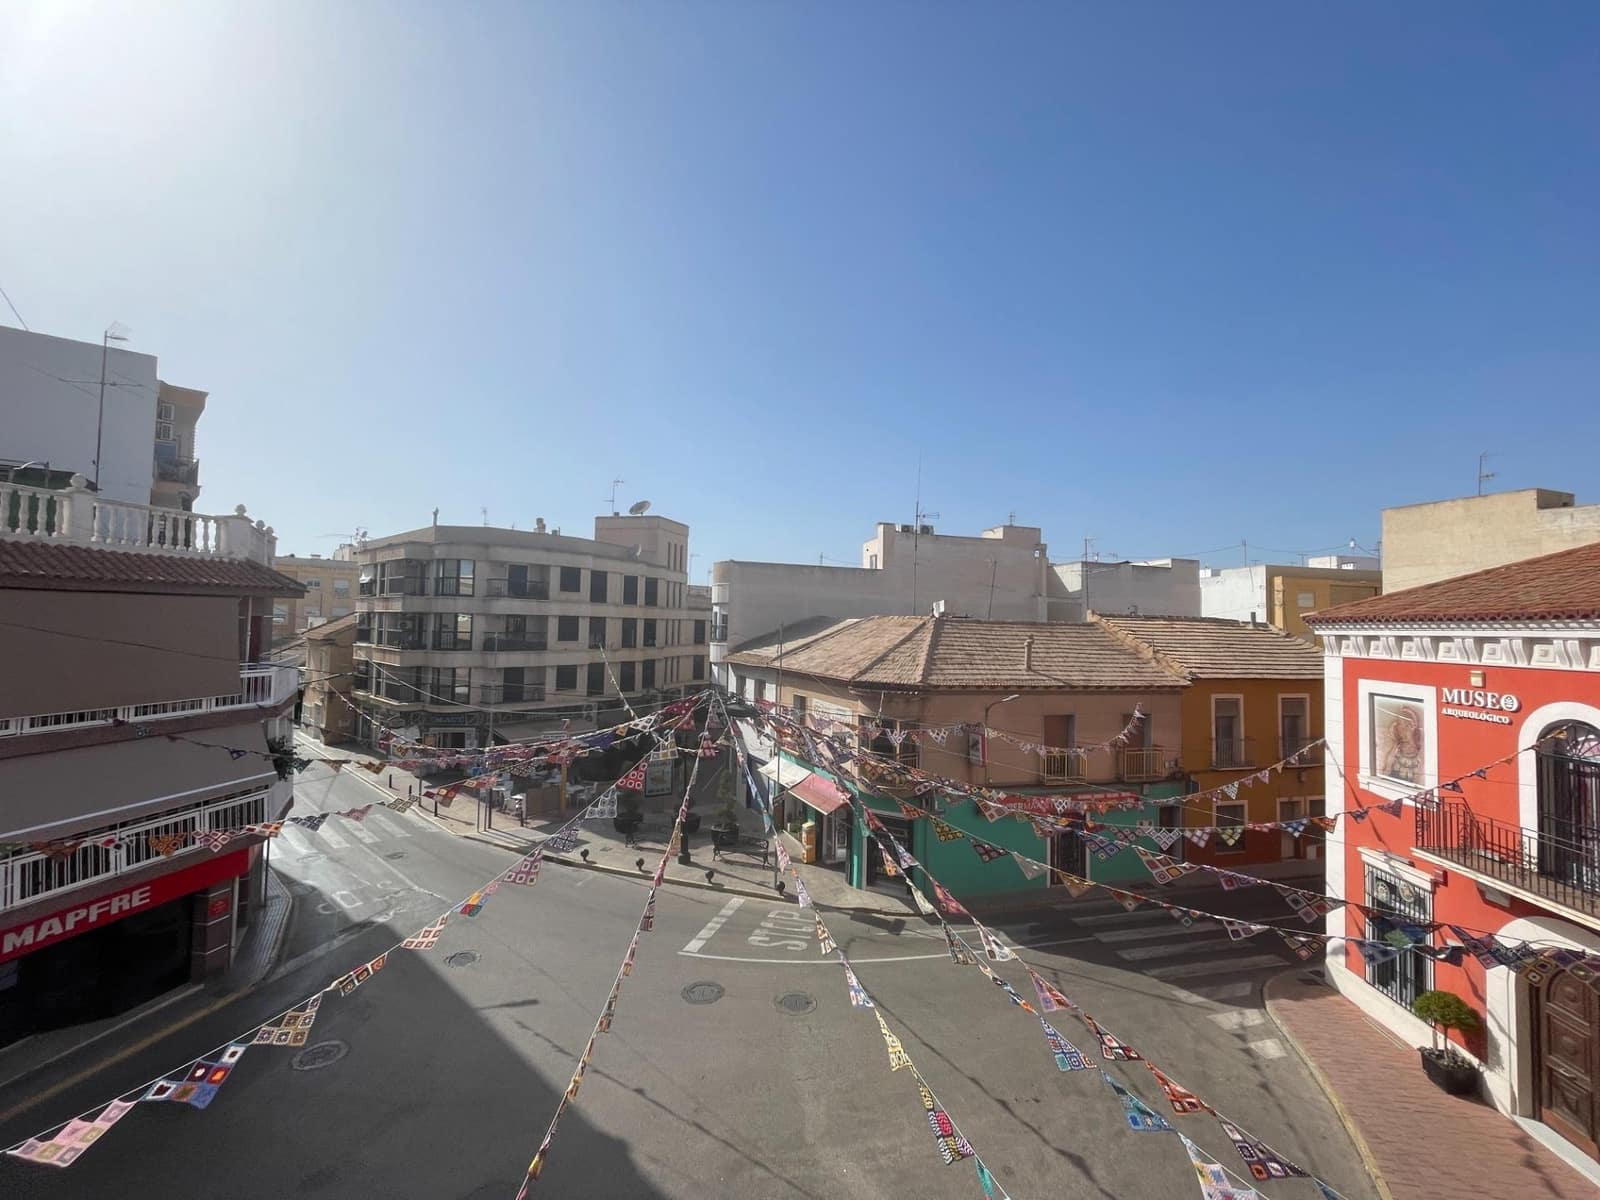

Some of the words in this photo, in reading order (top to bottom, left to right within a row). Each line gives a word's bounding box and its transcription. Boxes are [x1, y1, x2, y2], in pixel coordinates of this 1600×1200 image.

[1441, 688, 1520, 712] MUSEO
[2, 886, 152, 954] MAPFRE
[747, 910, 817, 951] STOP
